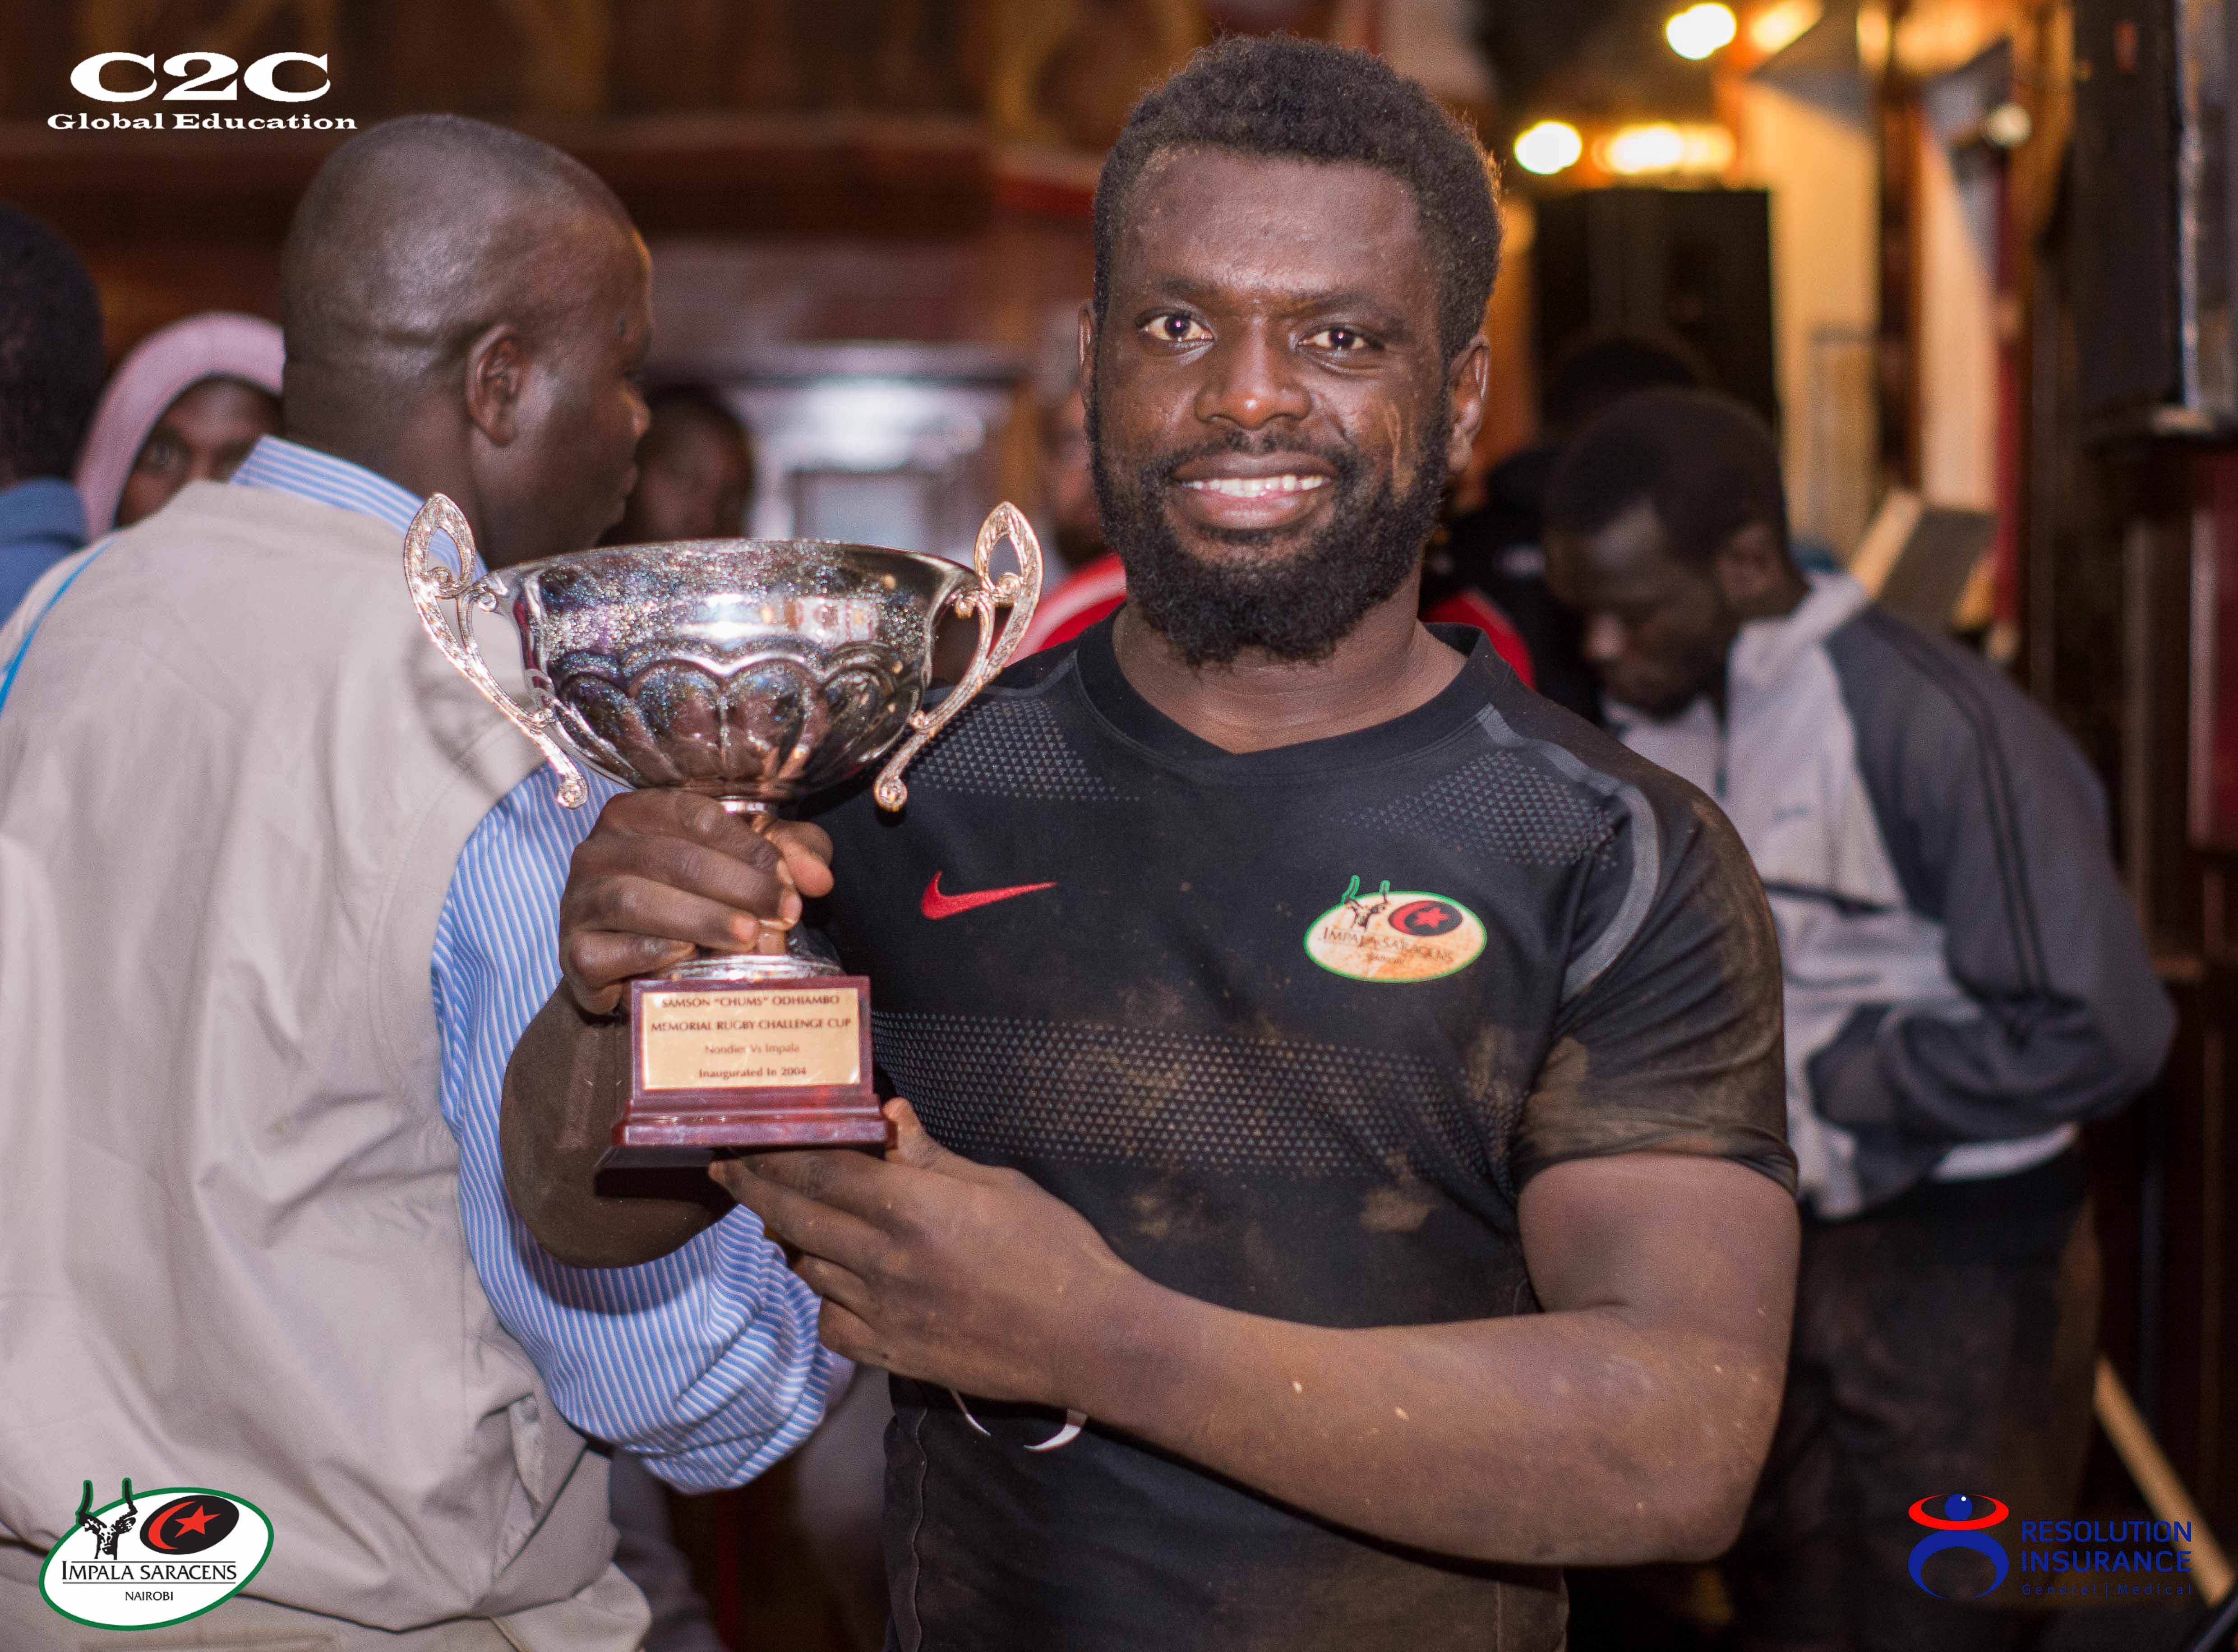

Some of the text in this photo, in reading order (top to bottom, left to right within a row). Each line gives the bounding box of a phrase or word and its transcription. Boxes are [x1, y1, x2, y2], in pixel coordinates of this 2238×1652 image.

[662, 995, 840, 1008] SAMSON "CHUMS" ODHIAMBO
[651, 1017, 852, 1032] MEMORIAL RUGBY CHALLENGE CUP
[766, 1041, 800, 1055] Impala
[699, 1066, 763, 1080] Inaugurated
[781, 1066, 807, 1076] 2004
